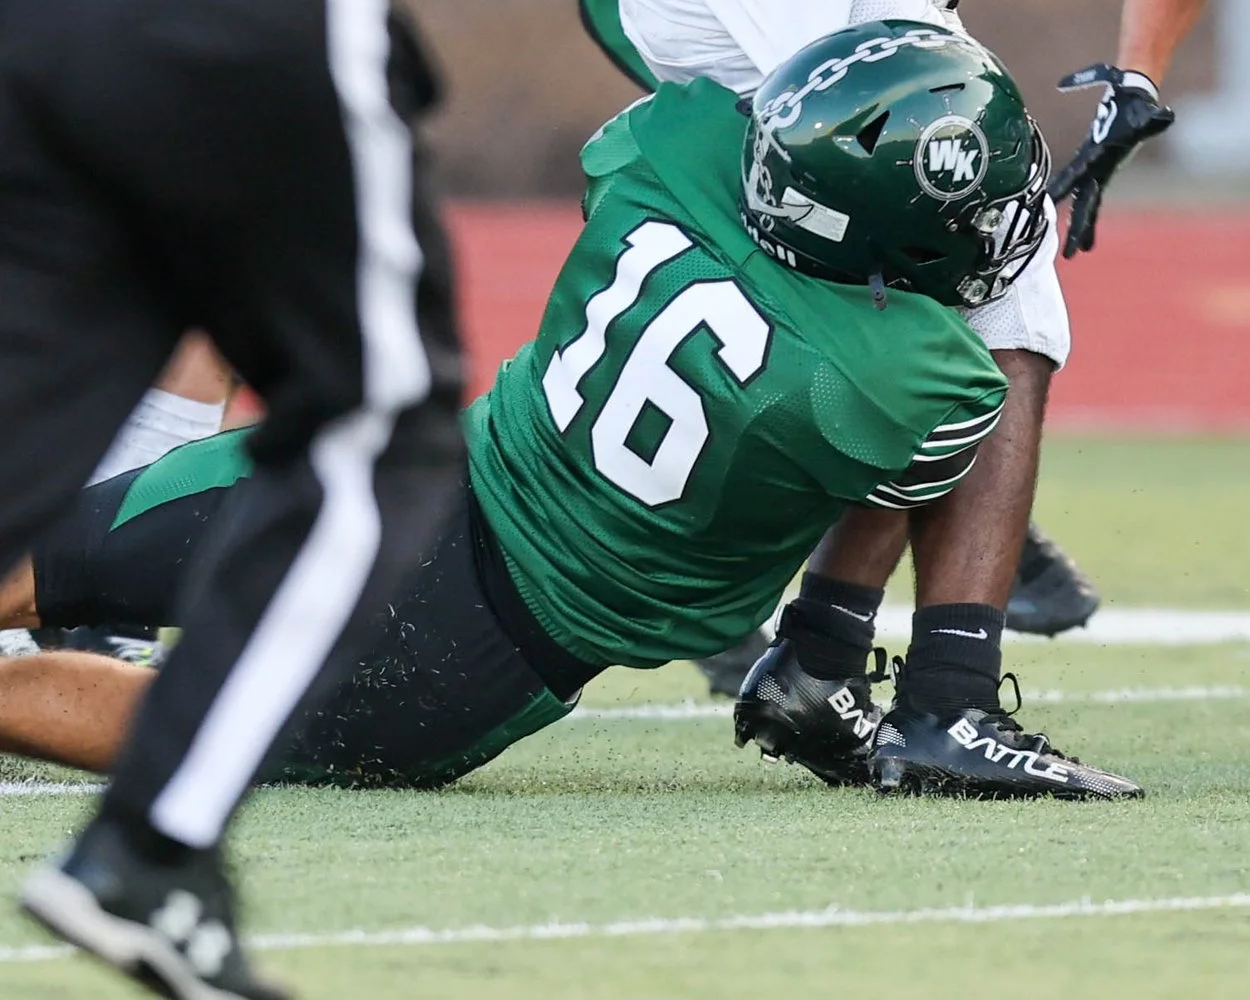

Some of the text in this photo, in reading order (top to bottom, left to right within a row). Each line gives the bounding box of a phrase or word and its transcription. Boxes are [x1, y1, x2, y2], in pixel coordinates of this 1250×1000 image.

[928, 139, 980, 182] WK
[541, 218, 772, 508] 16
[827, 686, 877, 745] BAT
[947, 717, 1070, 784] BATTLE
